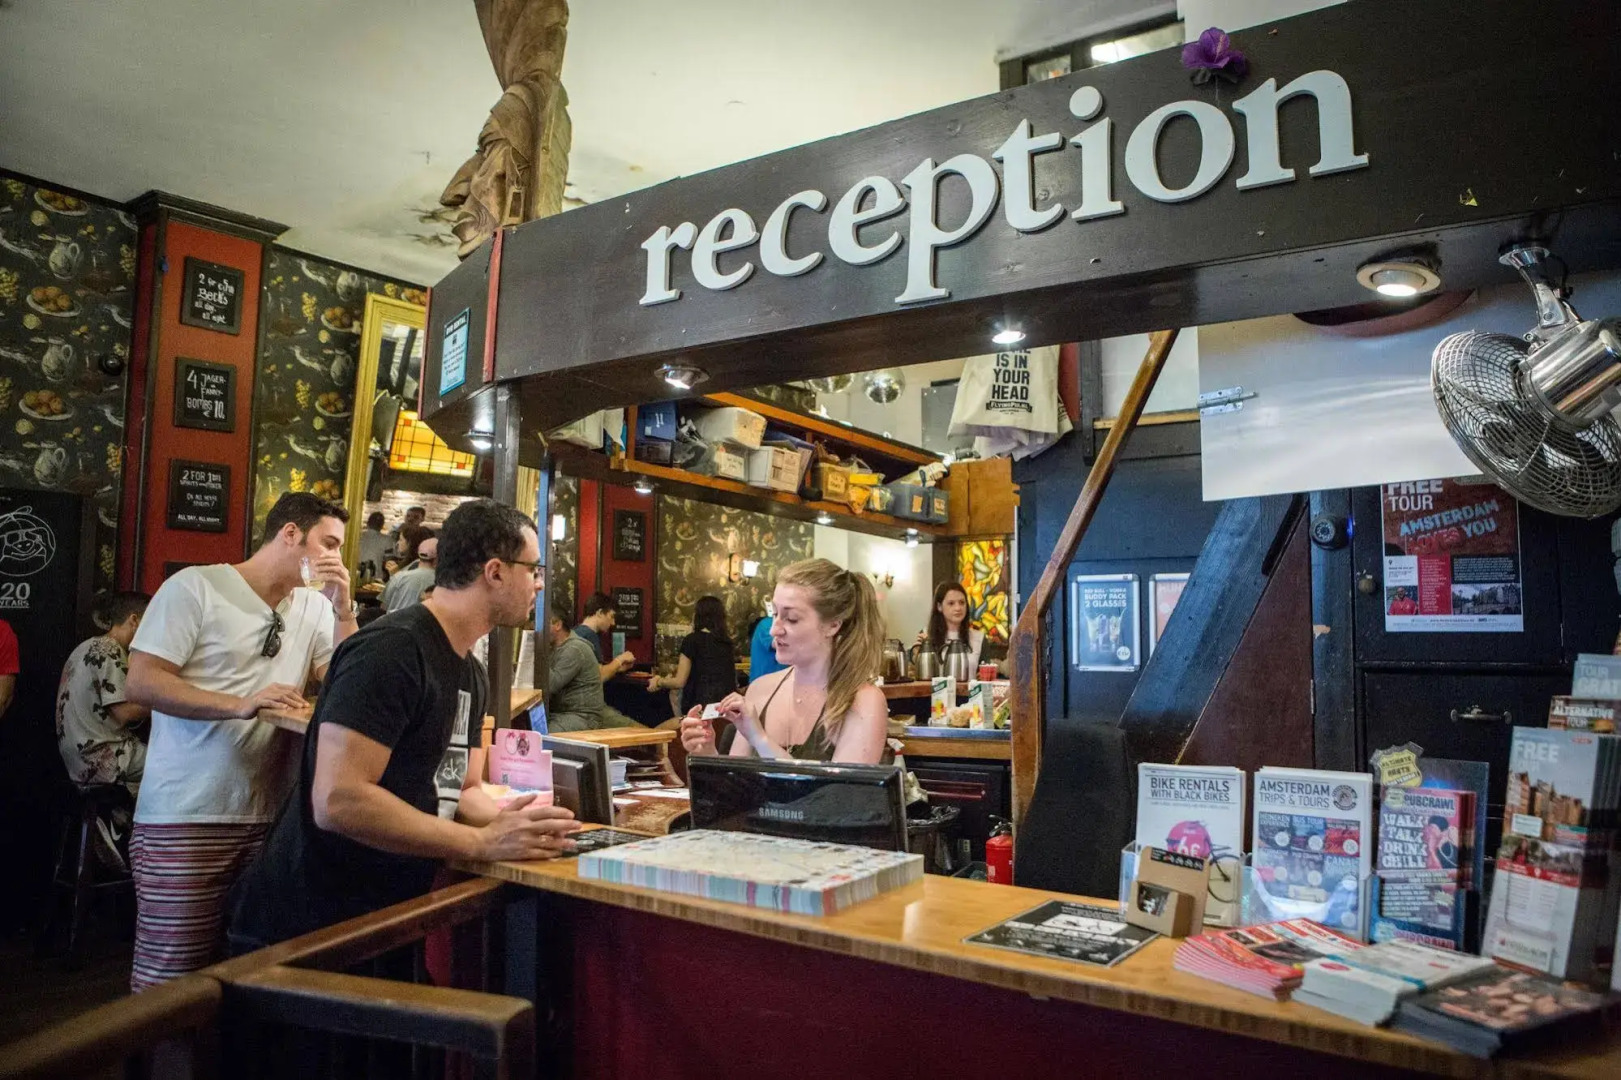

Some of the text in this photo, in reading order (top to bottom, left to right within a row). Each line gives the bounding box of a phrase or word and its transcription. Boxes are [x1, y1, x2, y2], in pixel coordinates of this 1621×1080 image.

[638, 68, 1369, 305] reception
[198, 273, 206, 285] 2
[996, 353, 1028, 369] IS IN
[186, 369, 198, 390] 4
[993, 368, 1030, 385] YOUR
[991, 383, 1029, 401] HEAD
[182, 470, 190, 480] 2
[190, 470, 206, 482] FOR
[1387, 479, 1444, 496] FREE
[1388, 494, 1434, 512] TOUR
[1399, 499, 1500, 537] AMSTERDAM
[1461, 516, 1498, 539] YOU
[0, 582, 31, 600] 20
[1092, 600, 1127, 608] GLASSES
[1553, 705, 1615, 719] ALTERNATIVE
[1515, 740, 1560, 764] FREE
[1150, 777, 1230, 792] BIKE RENTALS
[1259, 780, 1330, 797] AMSTERDAM
[1151, 789, 1230, 802] WITH BLACK BIKES
[1259, 792, 1286, 805] TRIPS
[1288, 796, 1295, 806] &
[1298, 796, 1330, 809] TOURS
[758, 807, 804, 820] SAMSUNG
[1382, 841, 1427, 857] DRINK
[1382, 853, 1426, 869] CHILL
